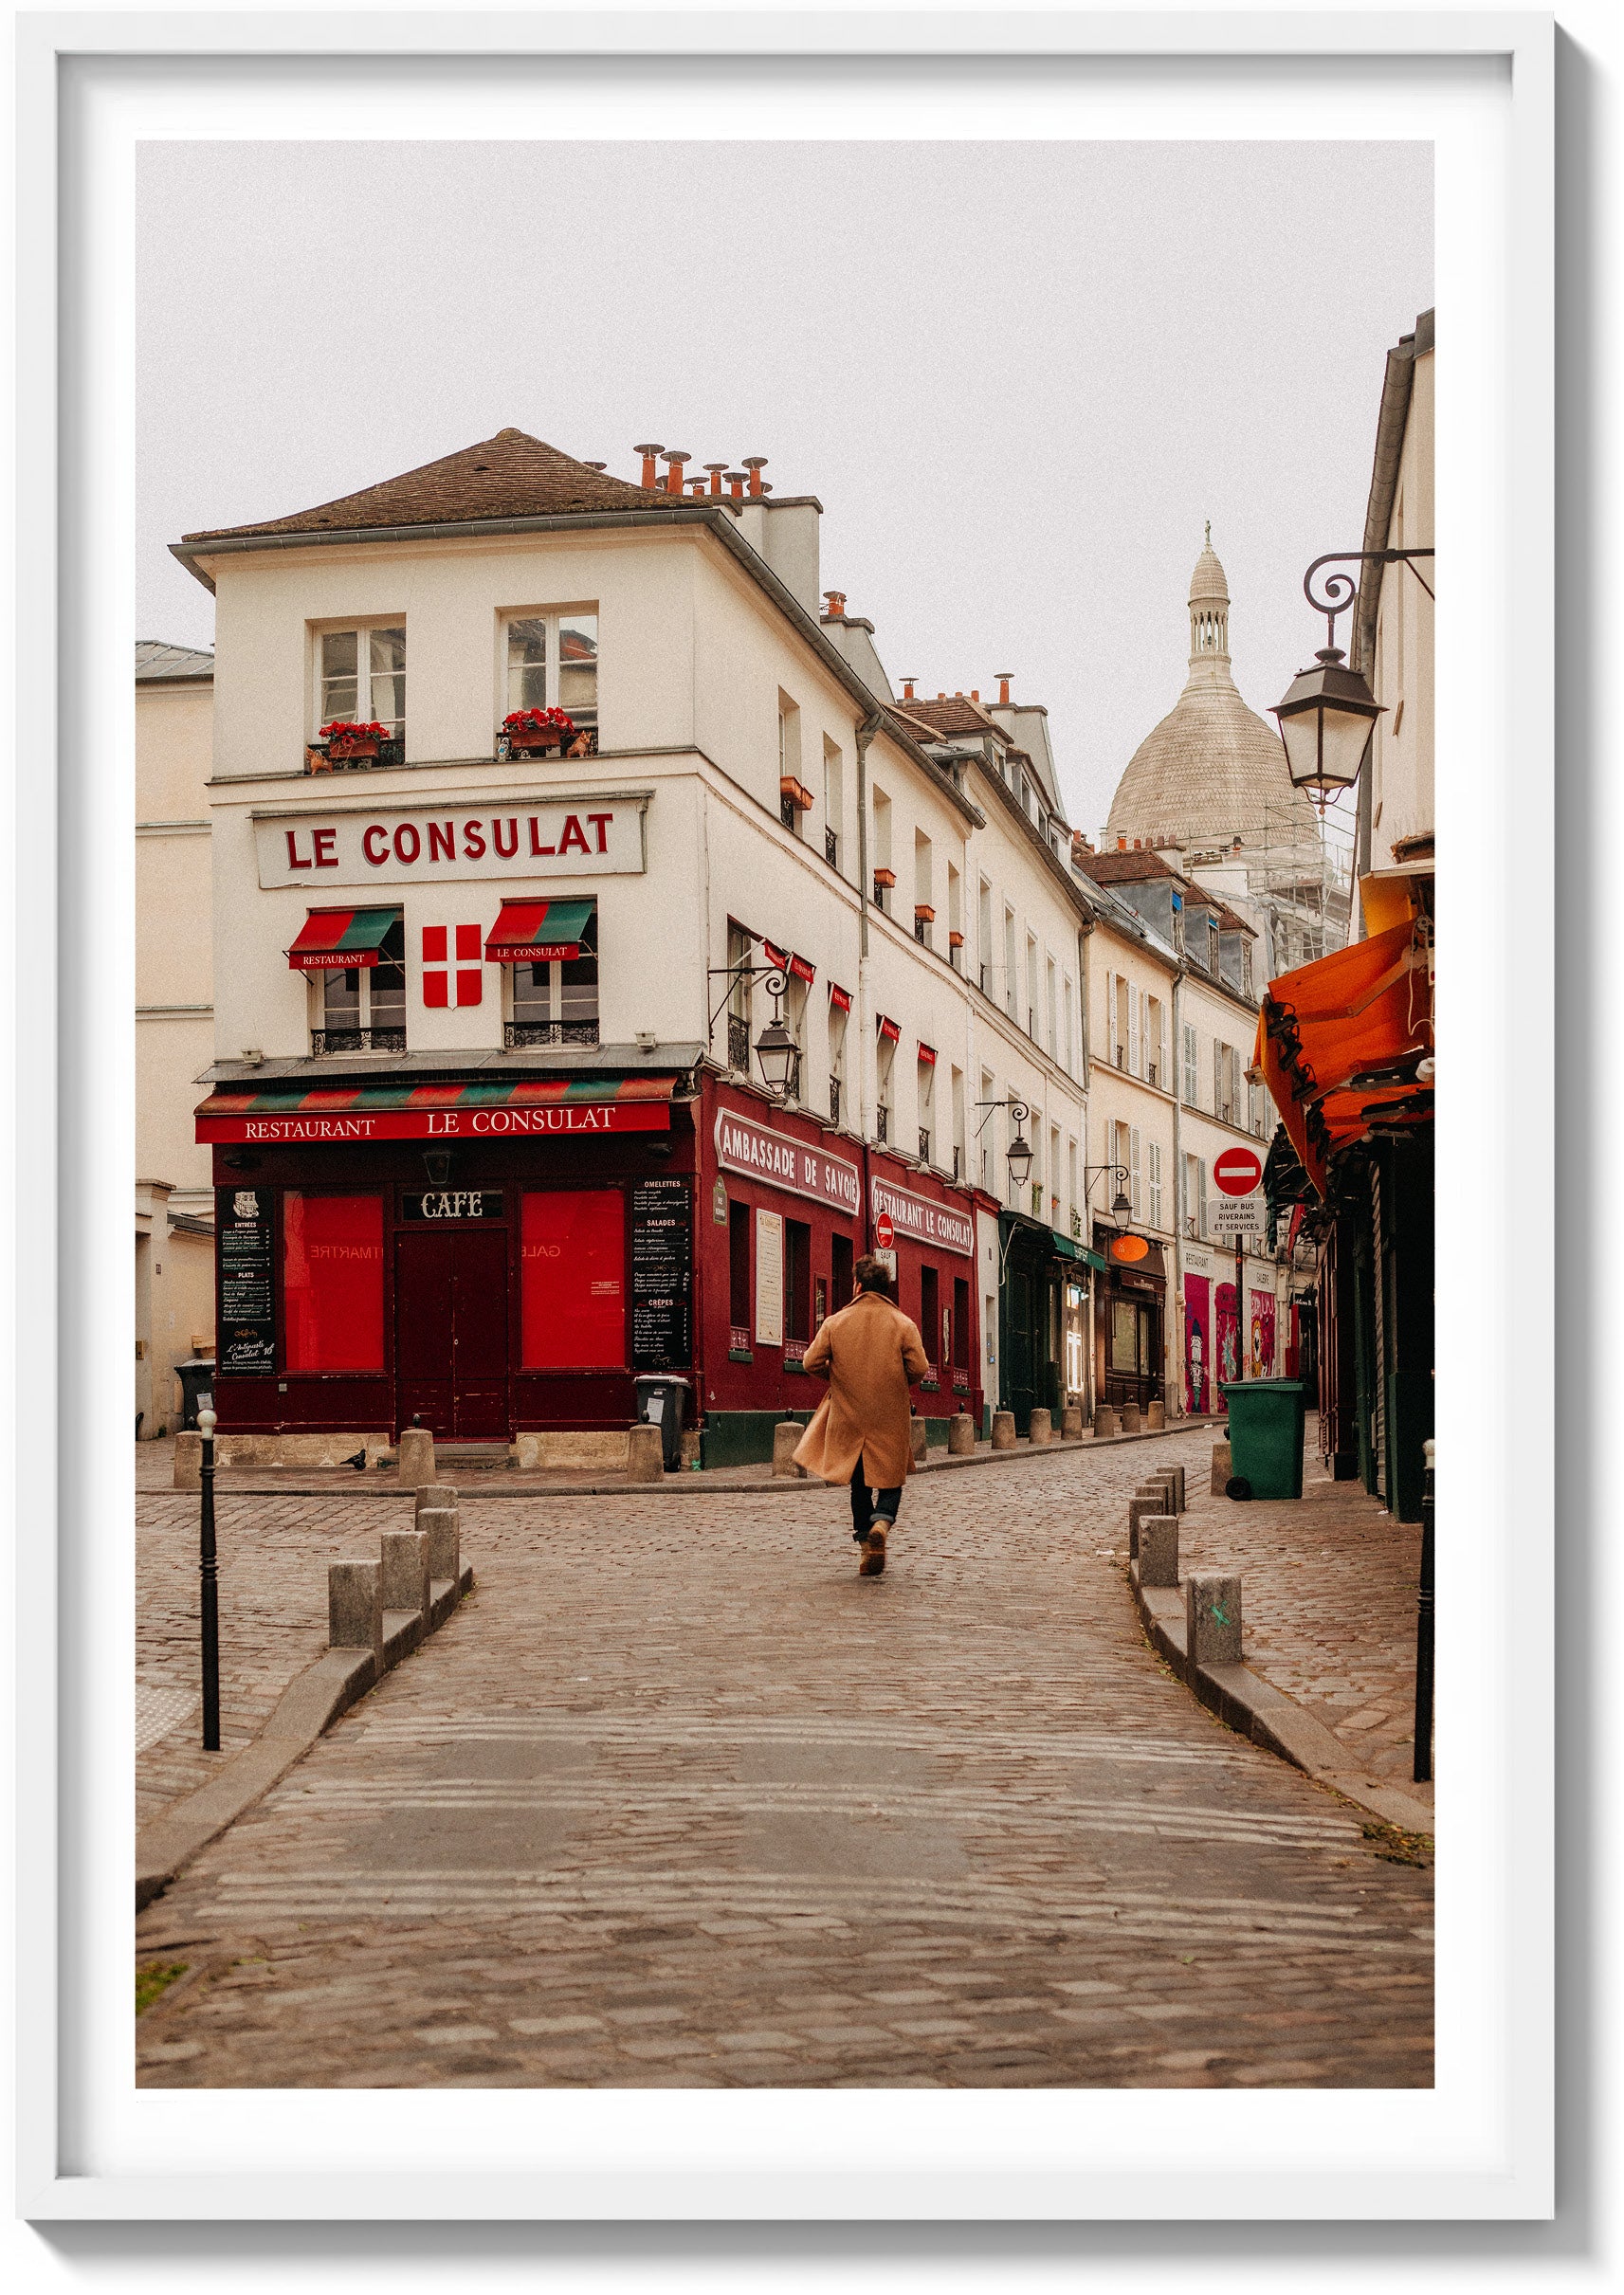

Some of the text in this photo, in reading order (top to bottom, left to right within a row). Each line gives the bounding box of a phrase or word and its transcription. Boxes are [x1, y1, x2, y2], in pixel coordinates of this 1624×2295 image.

[285, 812, 614, 871] LE CONSULAT
[302, 953, 365, 966] RESTAURANT
[497, 945, 567, 958] LE CONSULAT
[245, 1106, 616, 1138] RESTAURANT LE CONSULAT
[722, 1124, 857, 1204] AMBASSADE DE SAVOIE
[873, 1188, 971, 1248] RESTAURANT LE CONSULAT
[648, 1298, 674, 1306] CRÊPES
